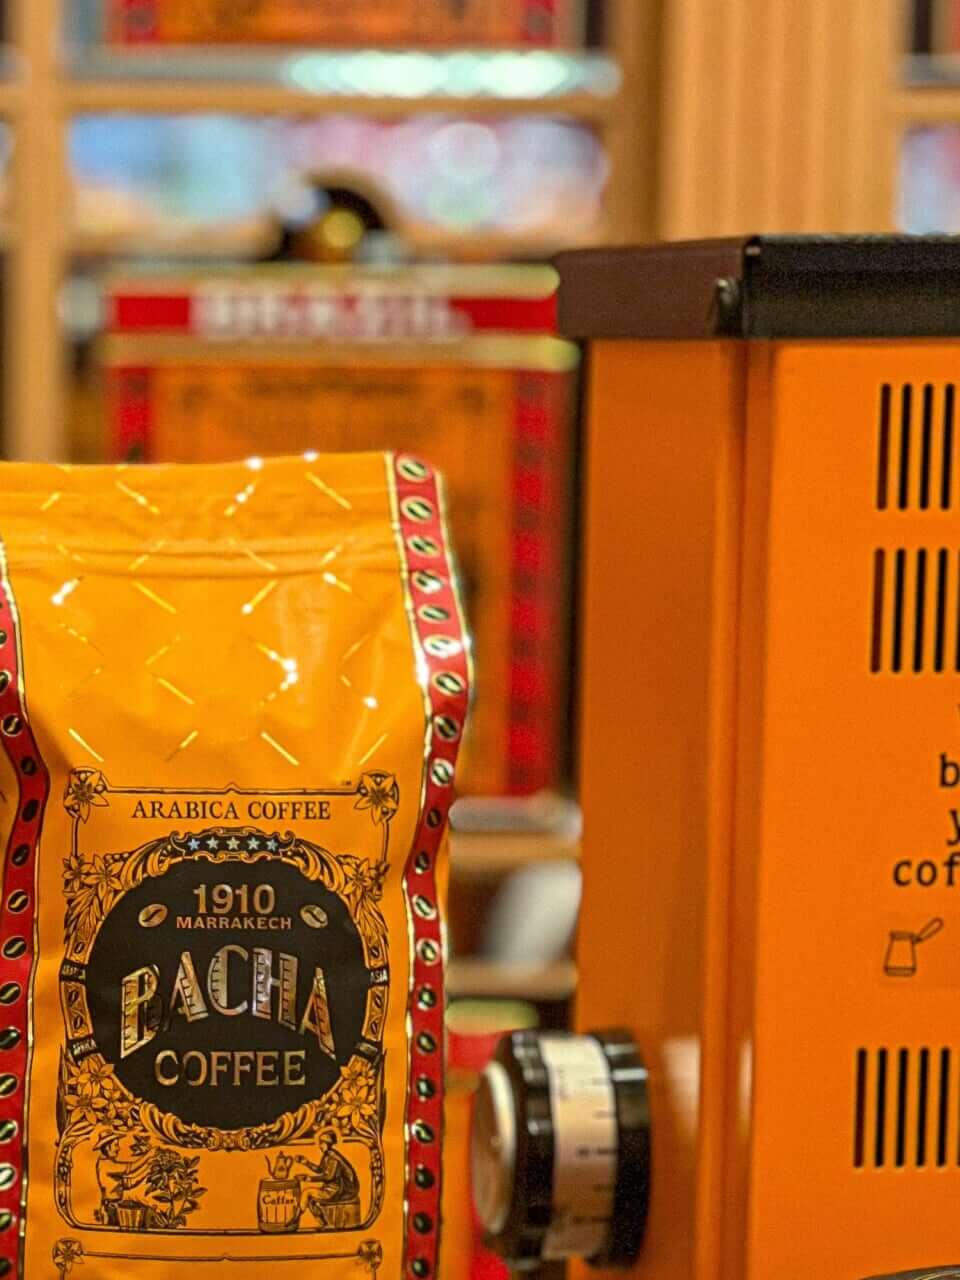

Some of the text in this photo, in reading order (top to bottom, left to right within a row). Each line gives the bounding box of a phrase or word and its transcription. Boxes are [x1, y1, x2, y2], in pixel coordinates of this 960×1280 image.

[131, 800, 331, 820] ARABICA COFFEE
[192, 883, 275, 915] 1910
[176, 915, 292, 931] MARRAKECH
[120, 944, 336, 1060] BACHA
[155, 1050, 307, 1087] COFFEE
